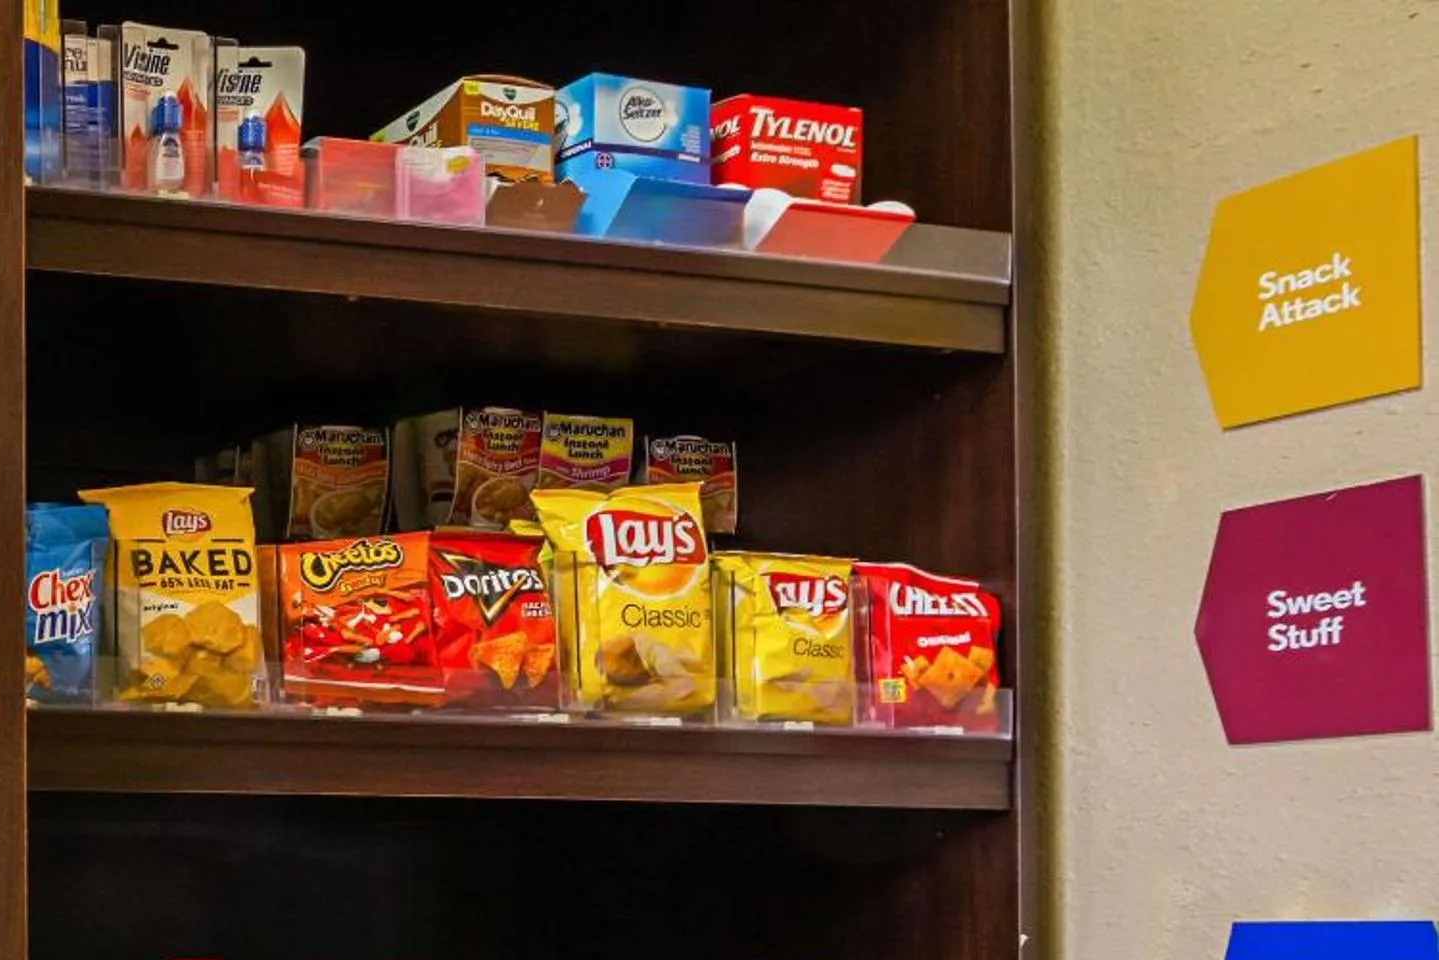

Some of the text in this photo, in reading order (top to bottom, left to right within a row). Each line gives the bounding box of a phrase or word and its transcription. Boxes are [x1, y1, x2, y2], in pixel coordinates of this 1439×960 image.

[123, 43, 172, 76] Visine
[480, 100, 537, 122] DayQuil
[749, 105, 858, 147] TYLENOL
[1258, 252, 1352, 300] Snack
[1258, 282, 1362, 331] Attack
[562, 422, 626, 438] Maruchan
[568, 449, 604, 460] Lunch
[165, 511, 209, 534] Lay's
[598, 511, 696, 566] Lay's
[131, 549, 252, 578] BAKED
[301, 541, 401, 588] Cheetos
[30, 569, 96, 611] Chex
[215, 579, 235, 590] FAT
[440, 569, 545, 599] Doritos
[1267, 581, 1367, 618] Sweet
[37, 603, 94, 641] mix
[621, 603, 702, 629] Classic
[1268, 616, 1344, 652] Stuff
